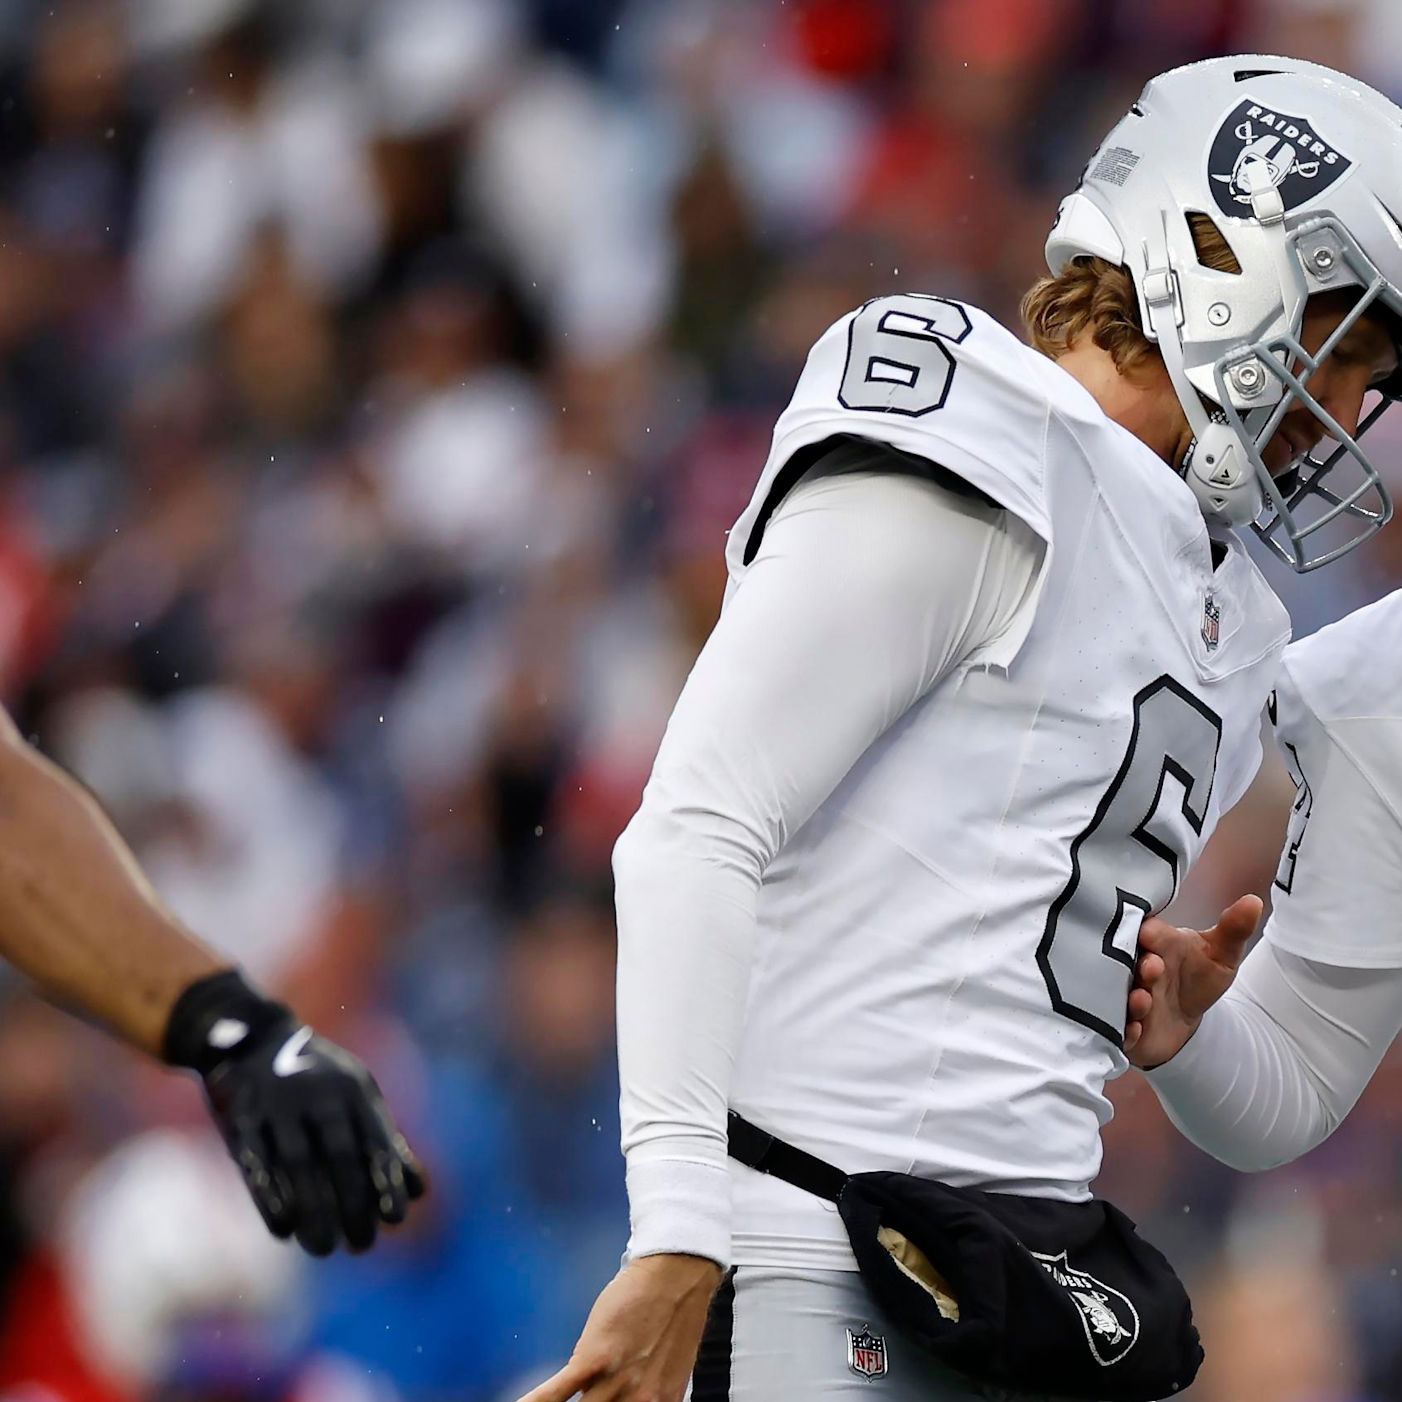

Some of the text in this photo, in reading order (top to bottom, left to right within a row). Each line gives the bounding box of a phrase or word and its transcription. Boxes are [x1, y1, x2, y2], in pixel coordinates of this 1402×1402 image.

[1246, 105, 1339, 165] RAIDERS
[837, 294, 973, 417] 6
[1036, 674, 1222, 1051] 6
[856, 1349, 882, 1372] NFL
